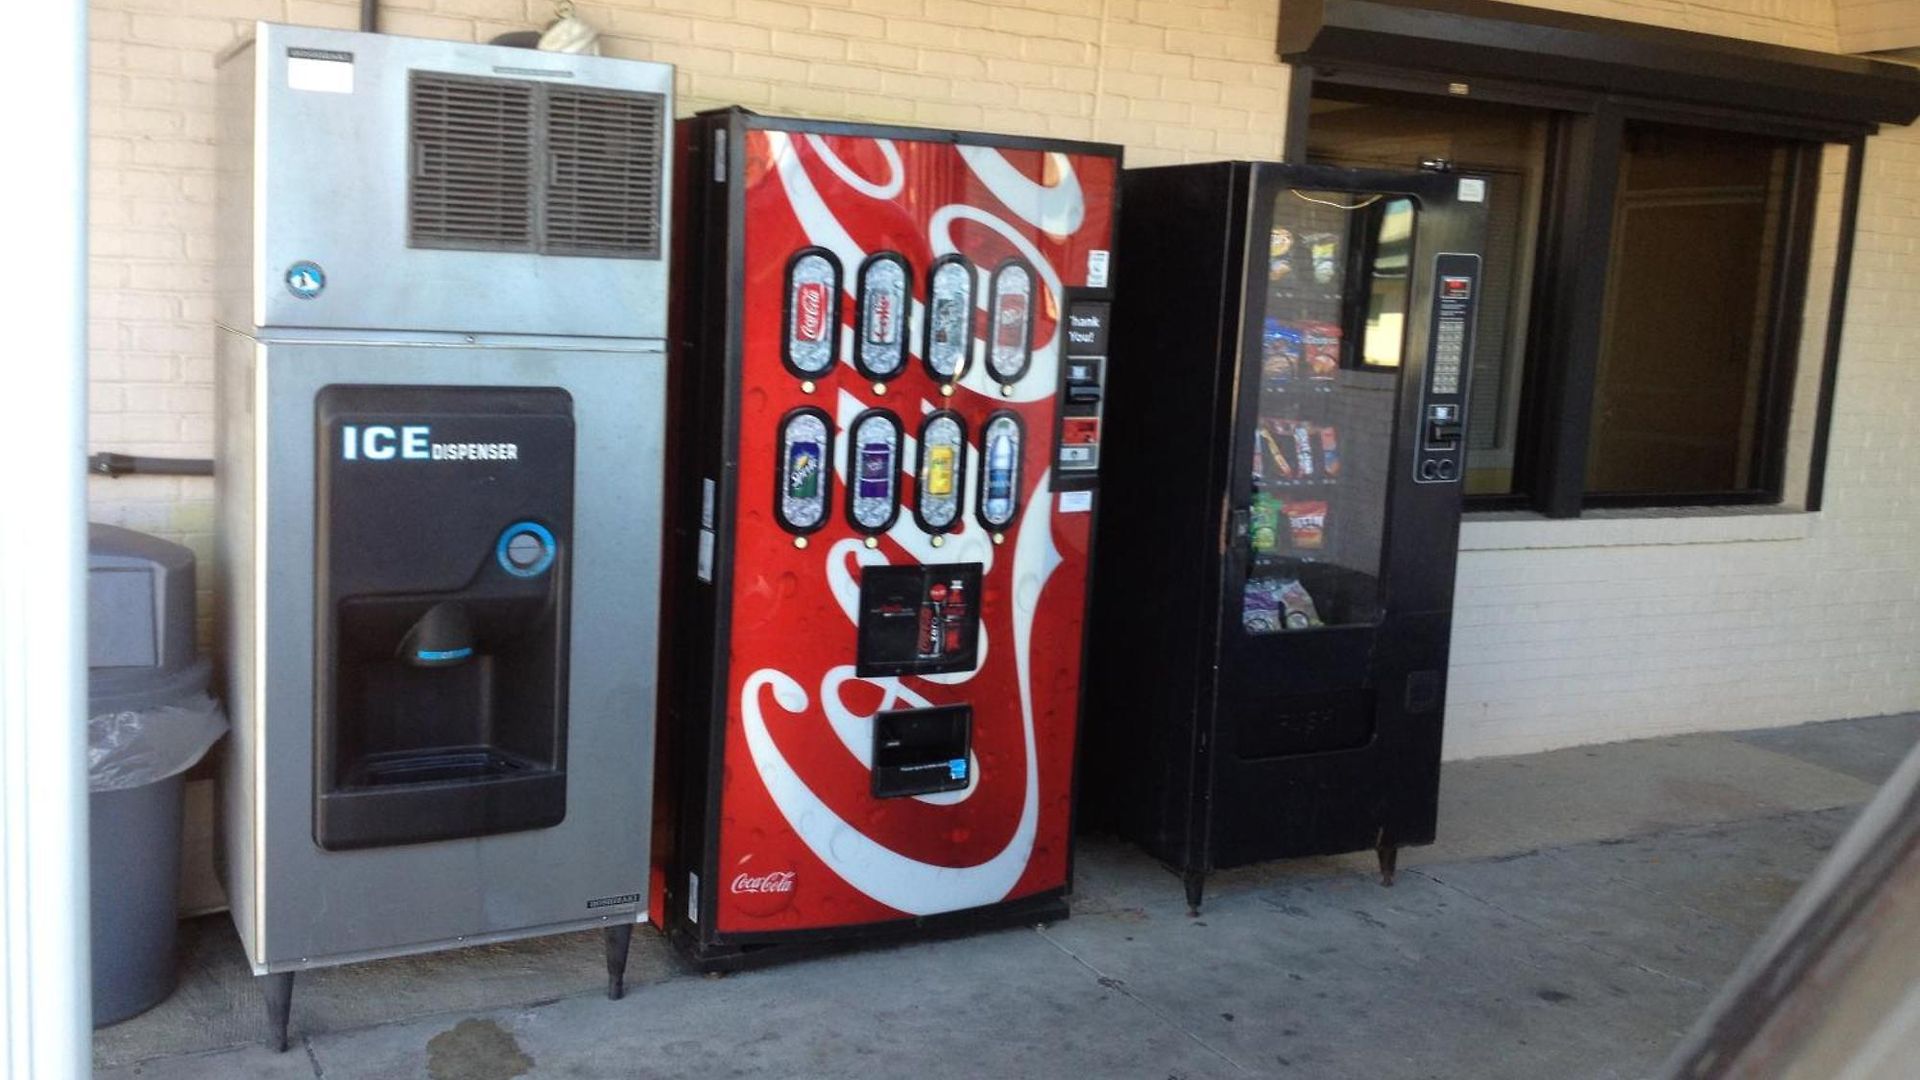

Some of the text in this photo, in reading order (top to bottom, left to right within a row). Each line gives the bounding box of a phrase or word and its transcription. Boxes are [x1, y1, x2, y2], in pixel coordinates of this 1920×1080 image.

[1069, 315, 1100, 327] Thank
[1068, 331, 1095, 343] You!
[343, 426, 518, 460] ICE DISPENSER
